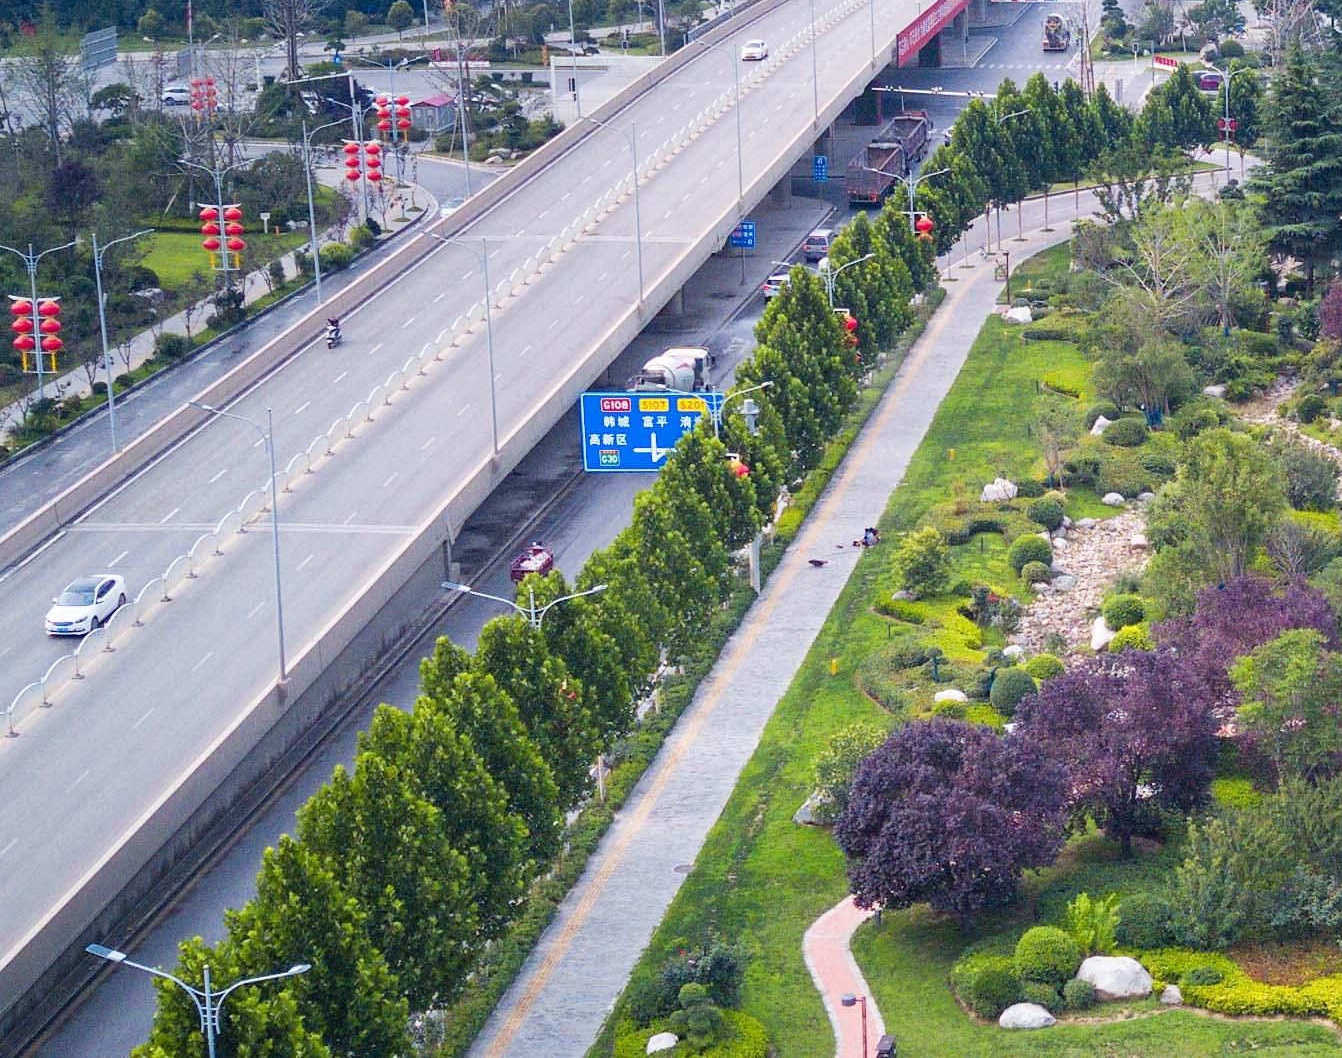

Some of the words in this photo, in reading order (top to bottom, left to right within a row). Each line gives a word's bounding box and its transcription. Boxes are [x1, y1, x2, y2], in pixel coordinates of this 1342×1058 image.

[603, 401, 629, 410] G108
[642, 401, 666, 410] S107
[680, 401, 705, 410] S201
[603, 416, 630, 428] 韩城
[642, 415, 668, 428] 富平
[589, 433, 627, 446] 高新区
[601, 455, 618, 464] G30
